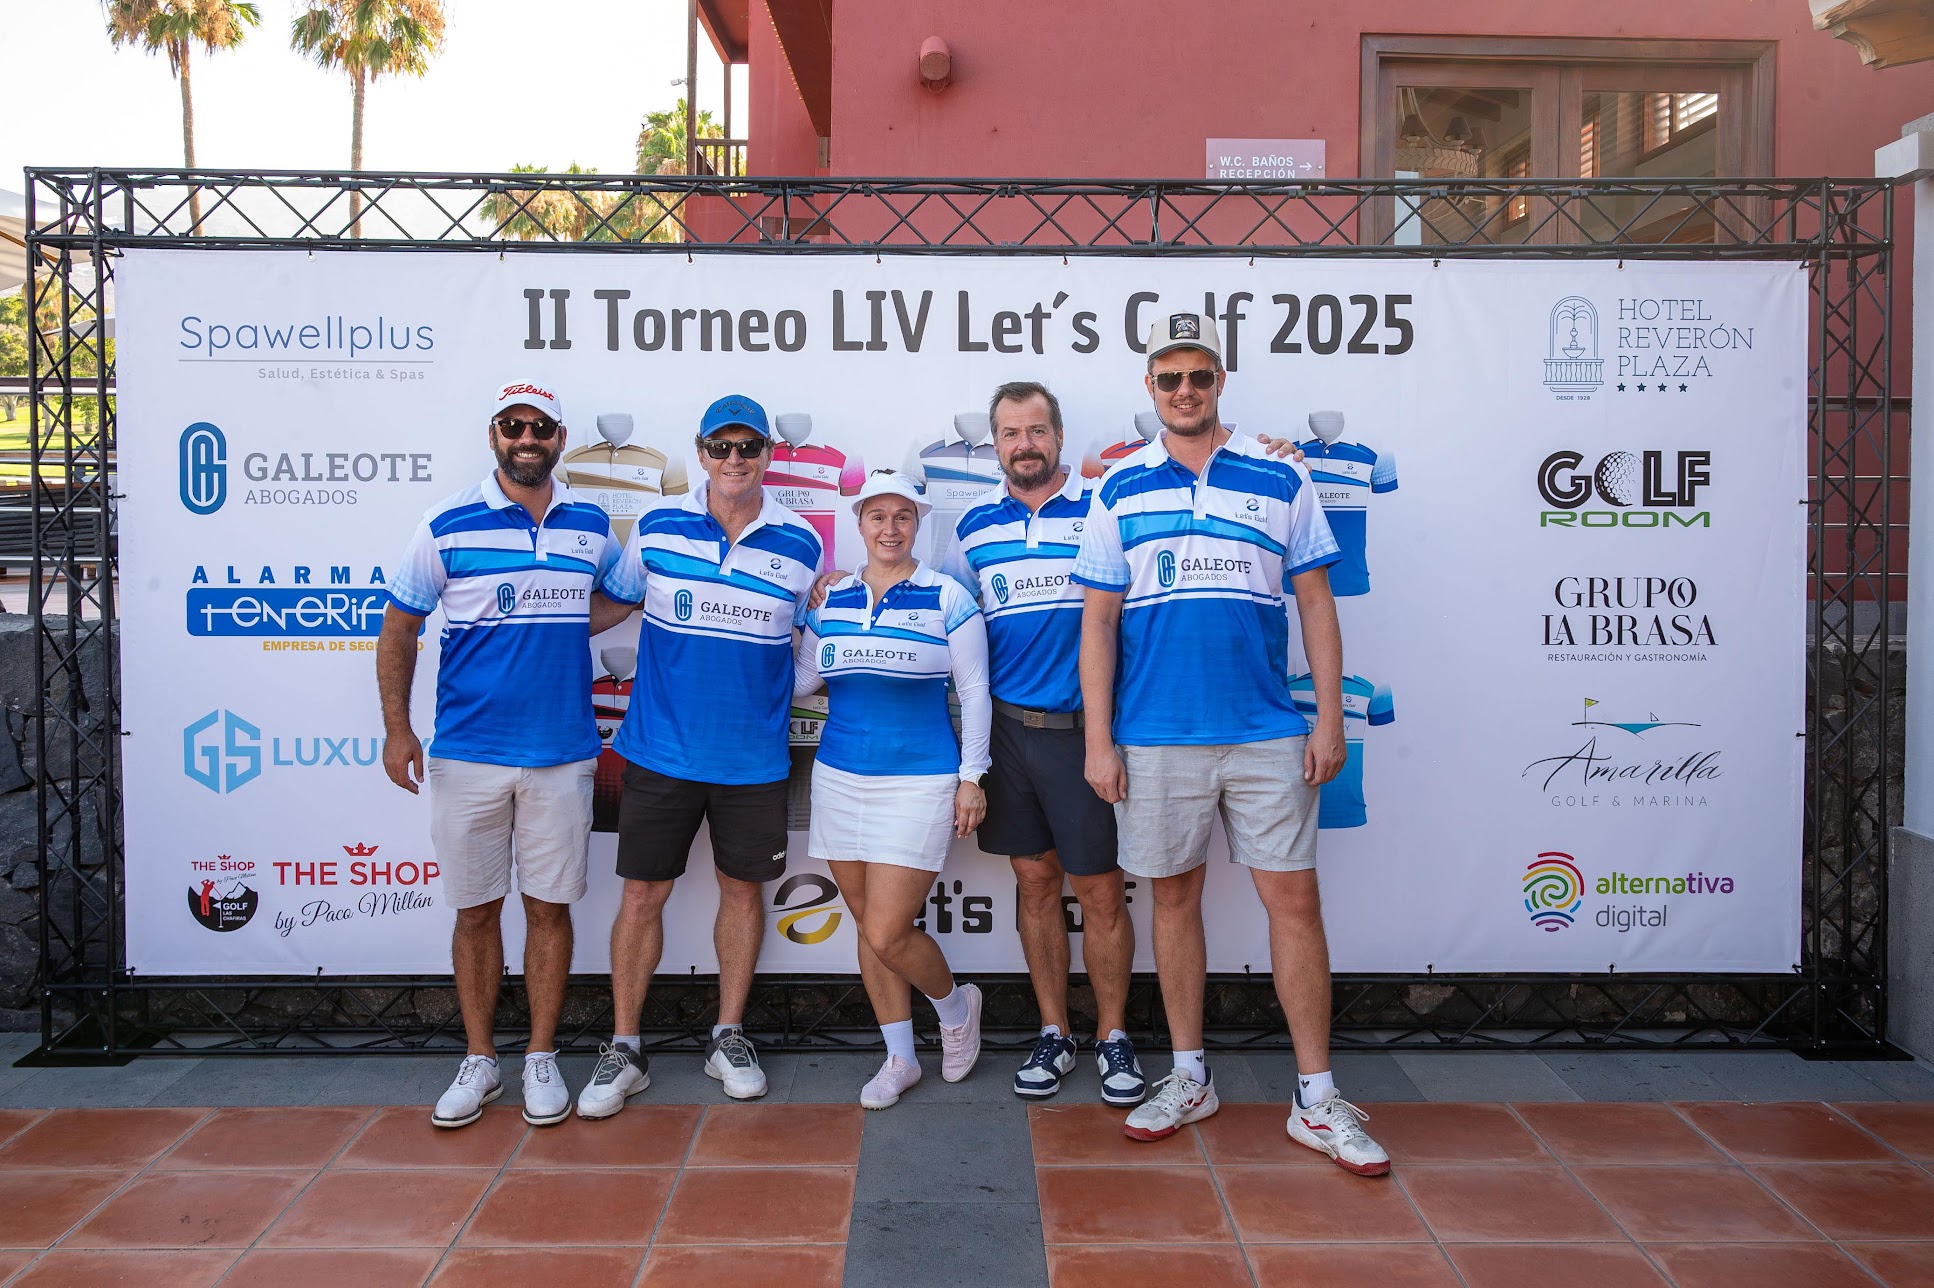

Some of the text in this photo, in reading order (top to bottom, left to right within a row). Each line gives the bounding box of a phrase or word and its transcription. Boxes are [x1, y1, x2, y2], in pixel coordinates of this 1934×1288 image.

[1219, 154, 1294, 167] W.C. BAÑOS
[1219, 167, 1296, 178] RECEPCIÓN
[1618, 298, 1712, 321] HOTEL
[180, 315, 434, 358] Spawellplus
[523, 288, 572, 350] II
[594, 289, 807, 352] Torneo
[832, 289, 933, 353] LIV
[1124, 291, 1254, 372] Glf
[1270, 293, 1414, 356] 2025
[1618, 322, 1754, 350] REVERÓN
[257, 367, 425, 382] Salud, Estética & Spas
[1617, 355, 1713, 377] PLAZA
[498, 383, 555, 401] Titleist
[243, 452, 432, 482] GALEOTE
[1537, 450, 1711, 510] GOLF
[244, 489, 358, 505] ABOGADOS
[1540, 511, 1710, 528] ROOM
[1180, 557, 1252, 574] GALEOTE
[191, 565, 386, 585] ALARMA
[1014, 574, 1080, 590] GALEOT
[1181, 573, 1228, 582] ABOGADOS
[522, 588, 586, 600] GALEOTE
[1016, 588, 1058, 599] ABOGADOS
[1554, 576, 1698, 609] GRUPO
[521, 601, 562, 609] ABOGADOS
[700, 601, 772, 623] GALEOTE
[699, 614, 743, 626] ABOGADOS
[1541, 614, 1719, 646] LA BRASA
[262, 640, 327, 652] EMPRESA
[329, 640, 346, 652] DE
[842, 648, 917, 662] GALEOTE
[1547, 652, 1708, 662] RESTAURACIÓN Y GASTRONOMÍA
[183, 708, 262, 794] GS
[273, 737, 431, 766] LUXU
[1521, 735, 1726, 793] Amarilla
[1551, 795, 1709, 807] GOLF & MARINA
[772, 850, 786, 861] adid
[191, 861, 255, 871] THE SHOP
[273, 861, 441, 886] THE SHOP
[1595, 871, 1735, 895] alternativa
[222, 902, 249, 911] GOLF
[274, 890, 434, 938] by Paco Millán
[914, 879, 993, 934] t's
[1595, 904, 1668, 933] digital
